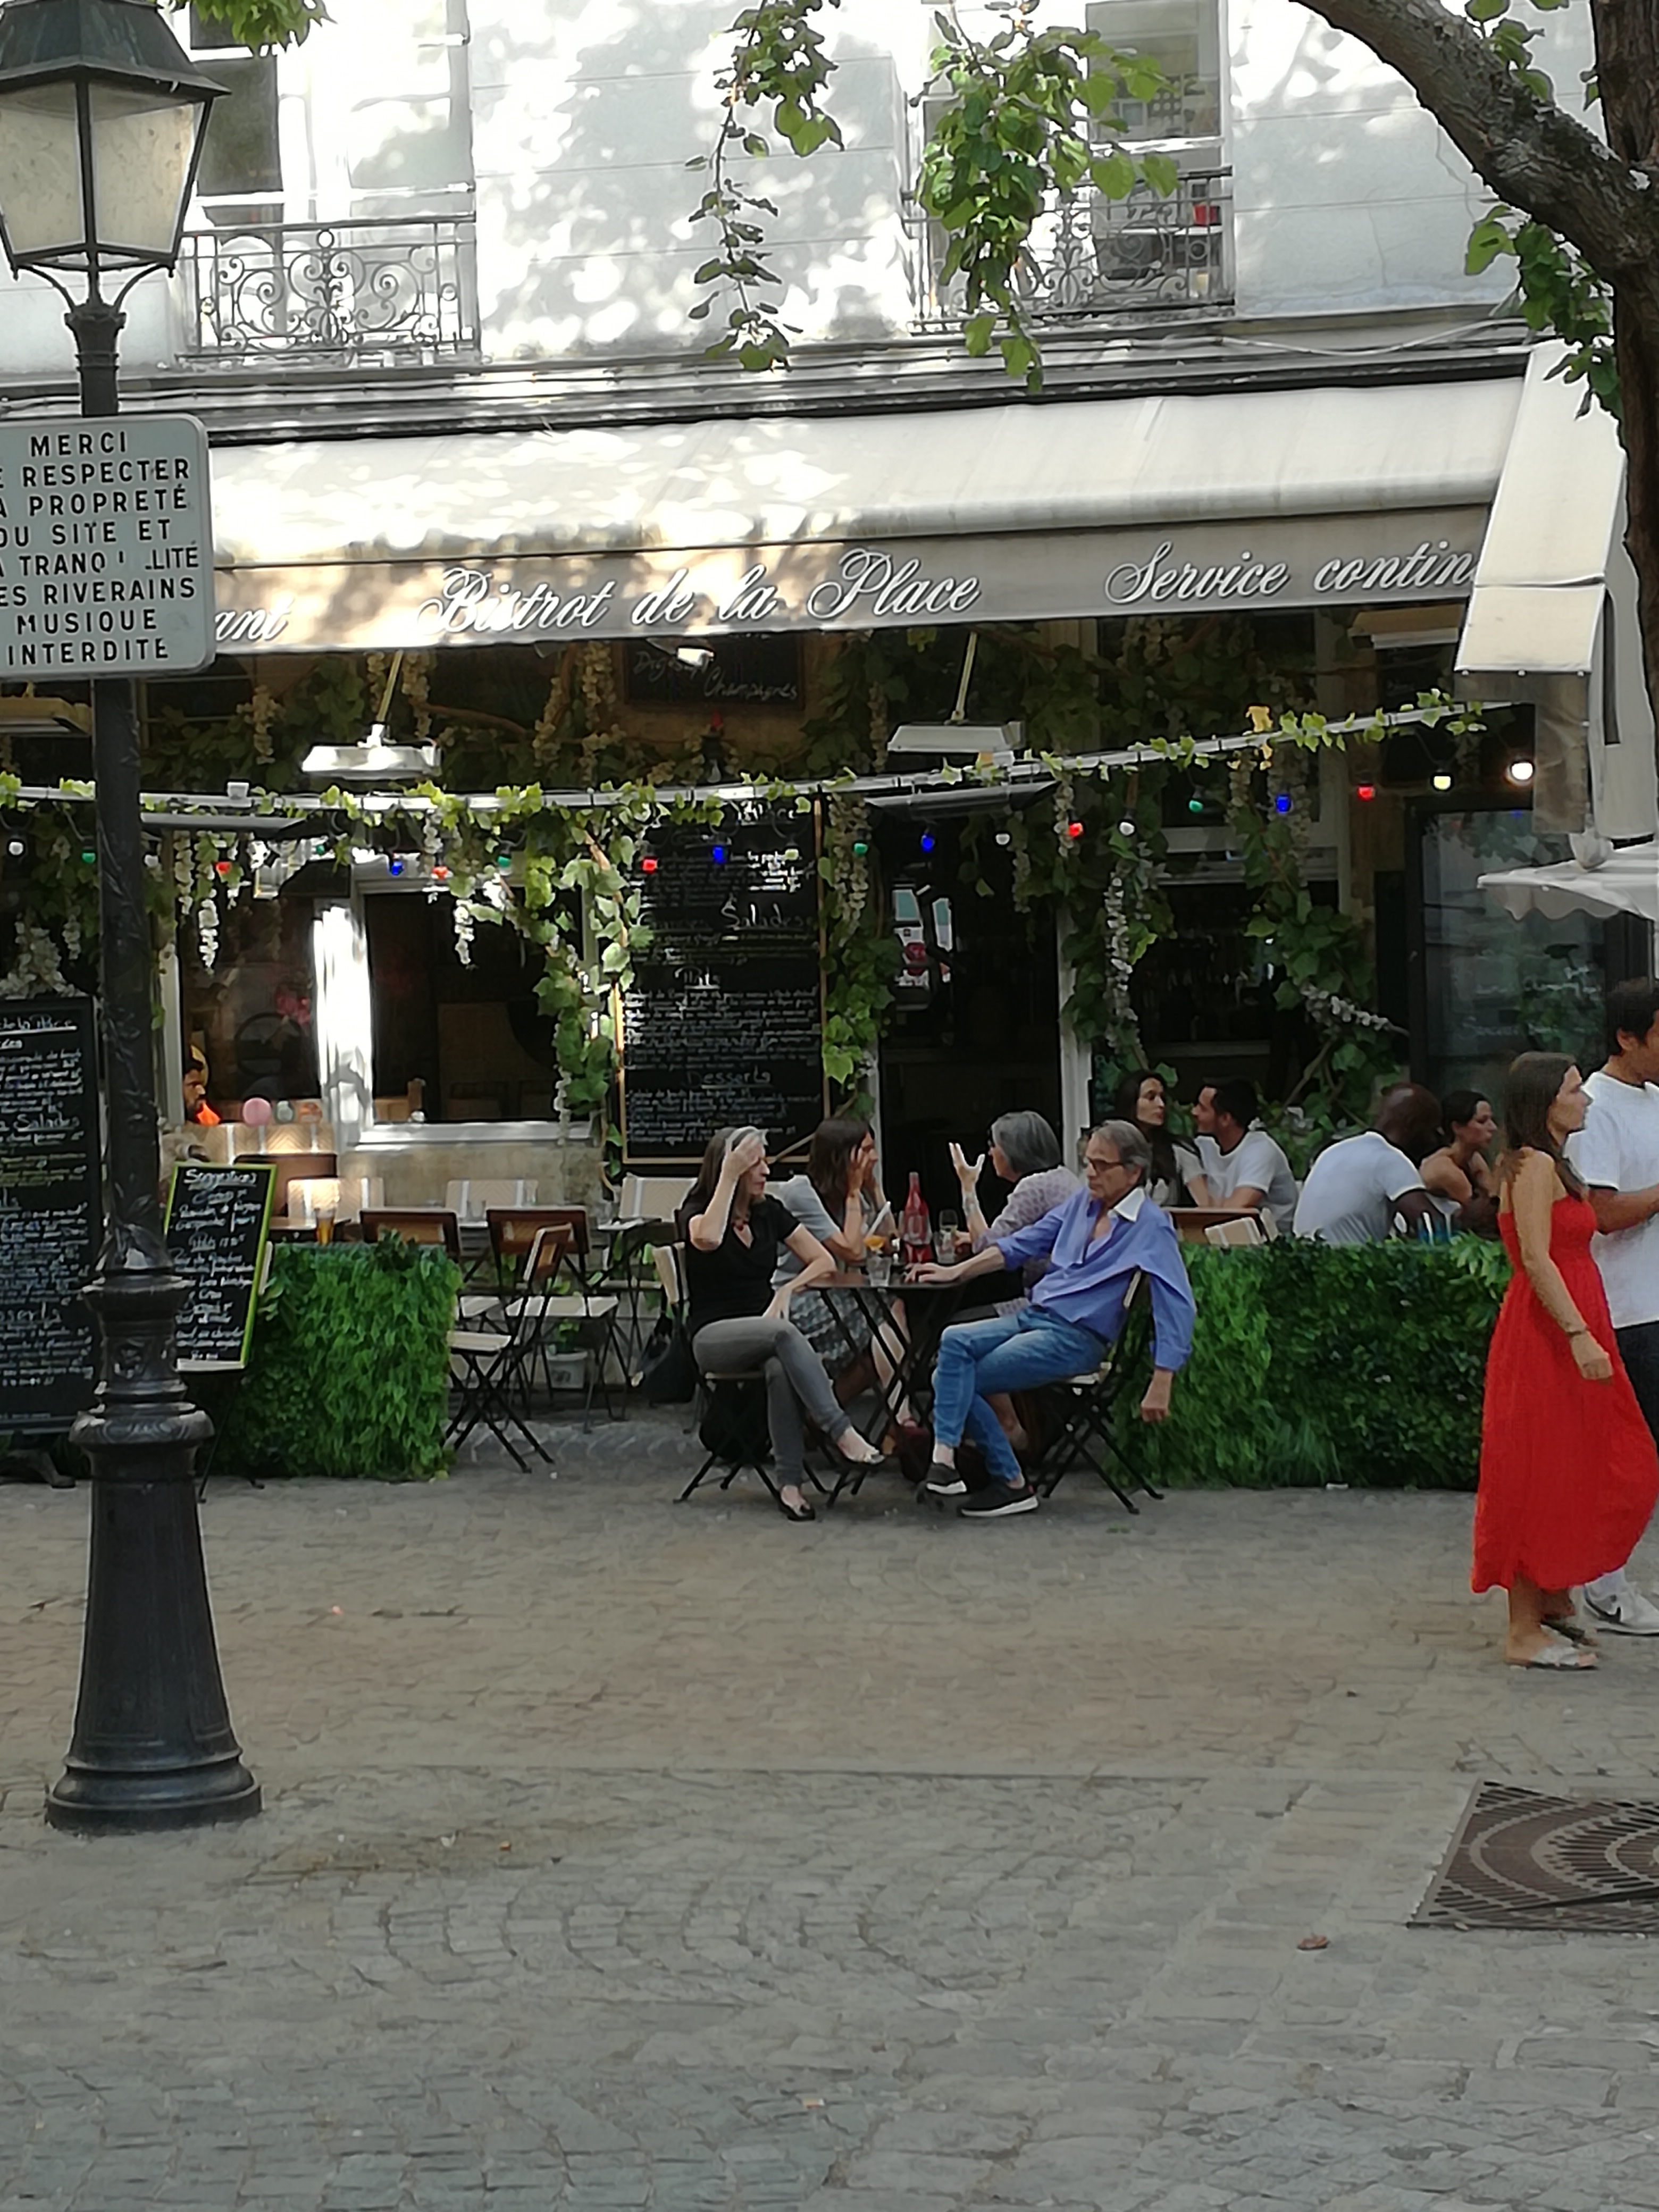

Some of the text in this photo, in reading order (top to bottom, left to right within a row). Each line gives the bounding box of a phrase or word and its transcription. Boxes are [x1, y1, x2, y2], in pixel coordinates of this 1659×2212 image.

[31, 431, 126, 457] MERCI
[23, 458, 189, 488] RESPECTER
[29, 484, 187, 516] PROPRETÉ
[52, 522, 116, 544] SITE
[139, 519, 170, 540] ET
[1105, 540, 1476, 604] Service contin
[44, 577, 195, 605] RIVERAINS
[417, 548, 982, 634] Bistrot de la Place
[17, 609, 157, 635] MUSIQUE
[9, 639, 169, 666] INTERDITE
